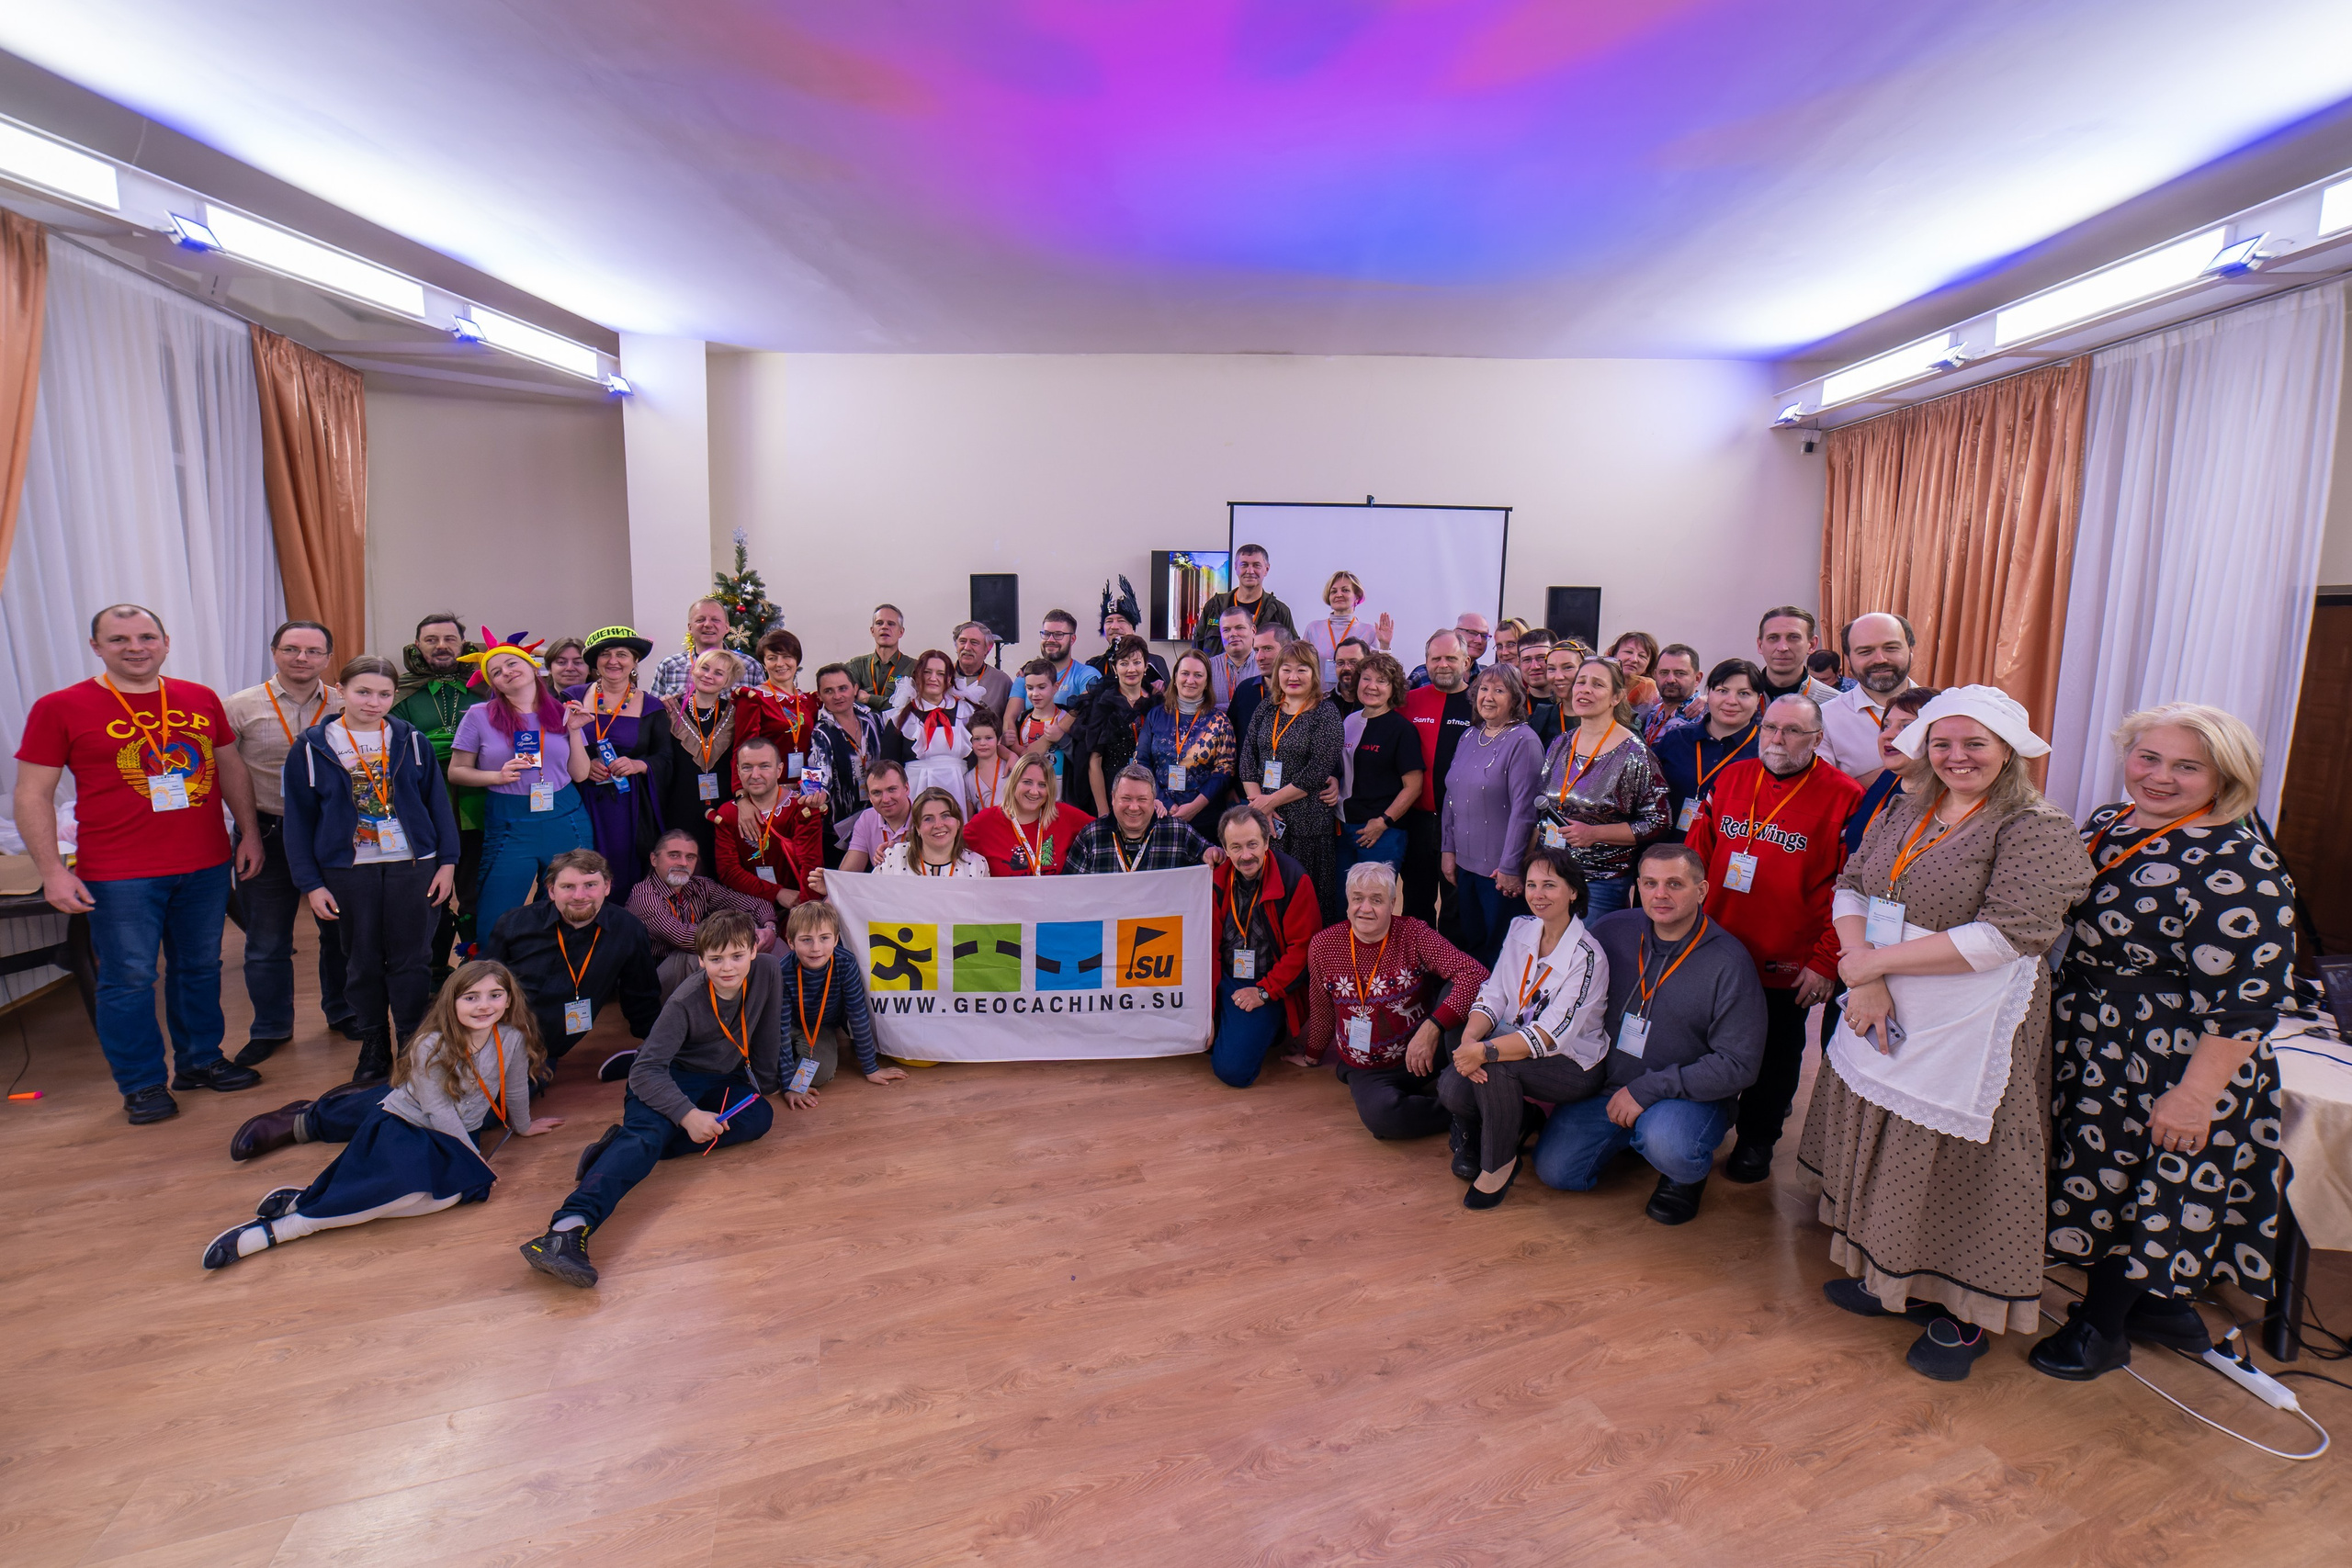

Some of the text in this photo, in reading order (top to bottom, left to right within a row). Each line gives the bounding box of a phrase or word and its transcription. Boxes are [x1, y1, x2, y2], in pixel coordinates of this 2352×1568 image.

[1720, 816, 1807, 852] Red Wings
[870, 992, 1183, 1015] WWW.GEOCACHING.SU
